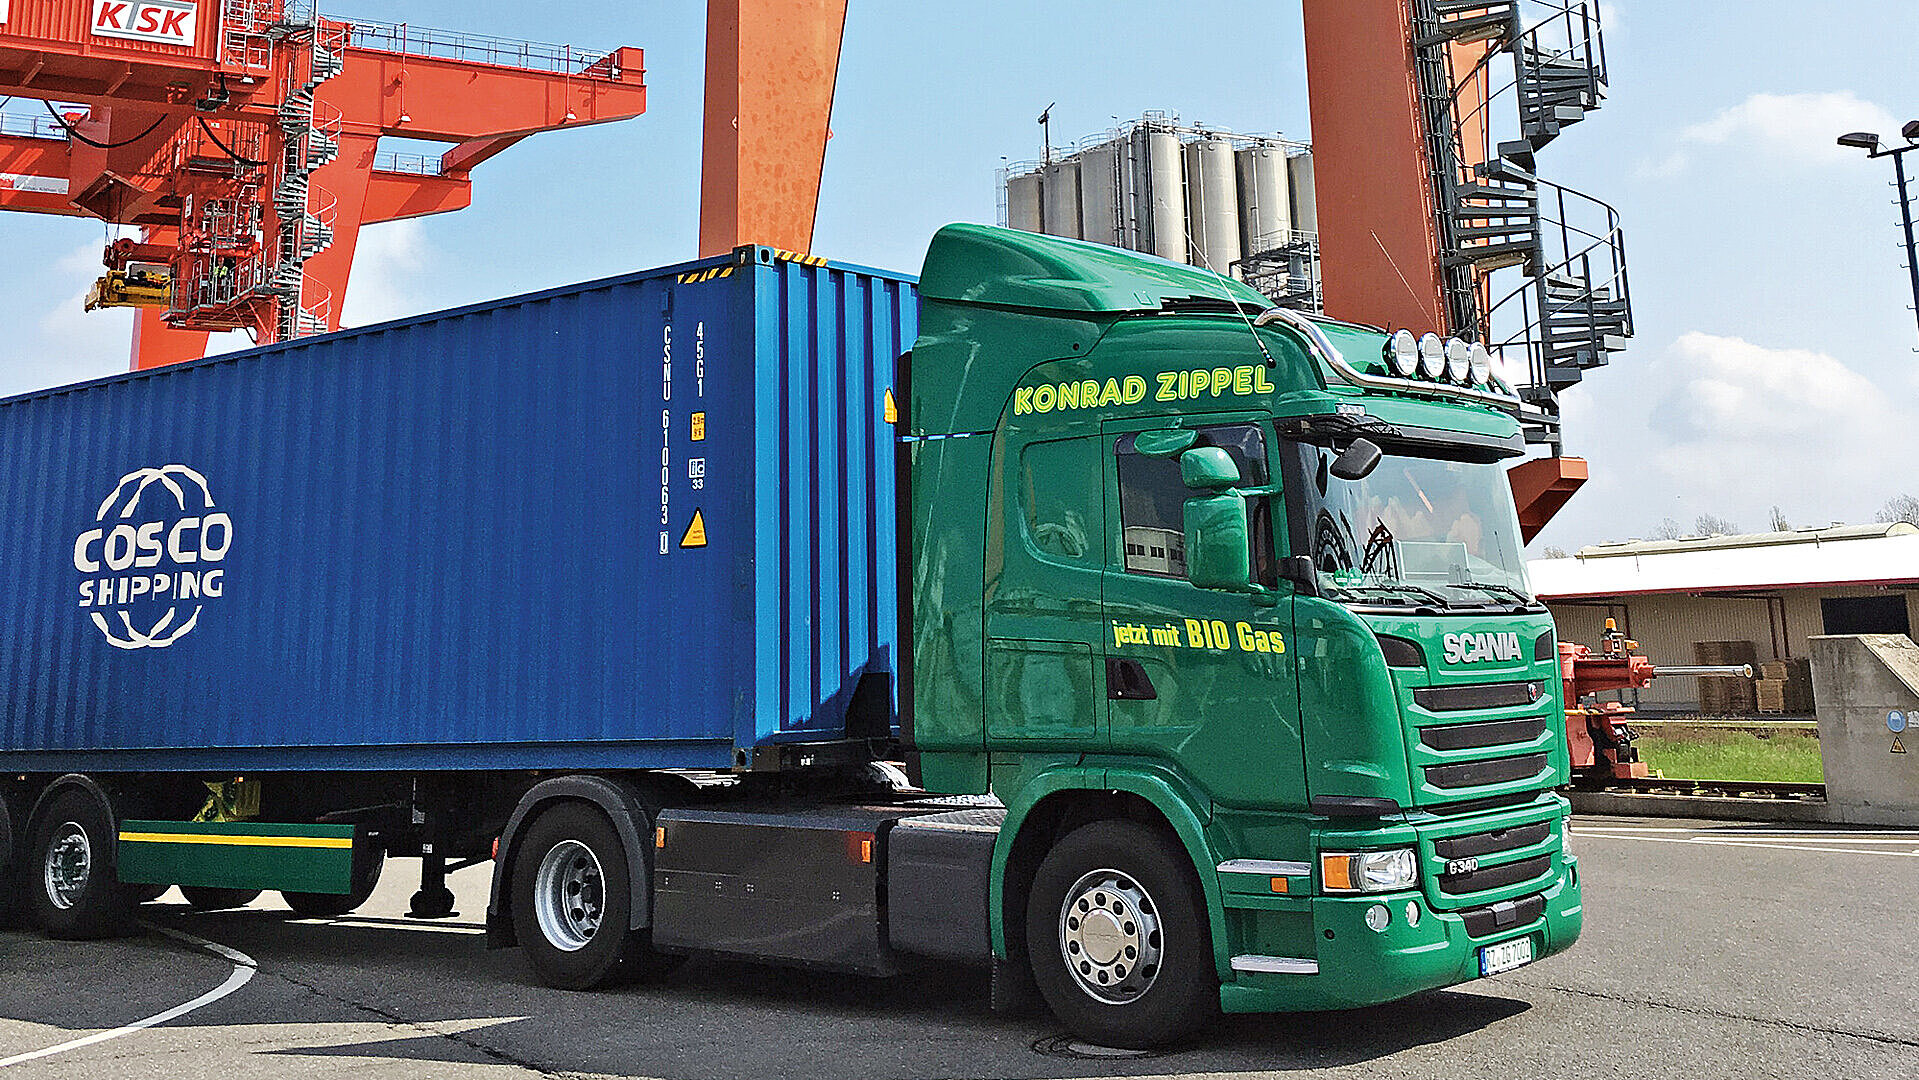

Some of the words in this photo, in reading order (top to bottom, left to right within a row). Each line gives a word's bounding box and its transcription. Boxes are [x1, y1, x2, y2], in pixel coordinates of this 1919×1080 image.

[663, 325, 672, 401] CSNU
[696, 321, 704, 397] 45G1
[1014, 375, 1147, 416] KONRAD
[1155, 364, 1275, 402] ZIPPEL
[661, 408, 670, 525] 610063
[692, 478, 704, 490] 33
[73, 512, 233, 573] COSCO
[78, 569, 224, 607] SHIPPING
[1111, 619, 1150, 648] jetzt
[1151, 623, 1182, 647] mit
[1184, 618, 1231, 650] BIO
[1235, 621, 1286, 654] Gas
[1443, 632, 1523, 664] SCANIA
